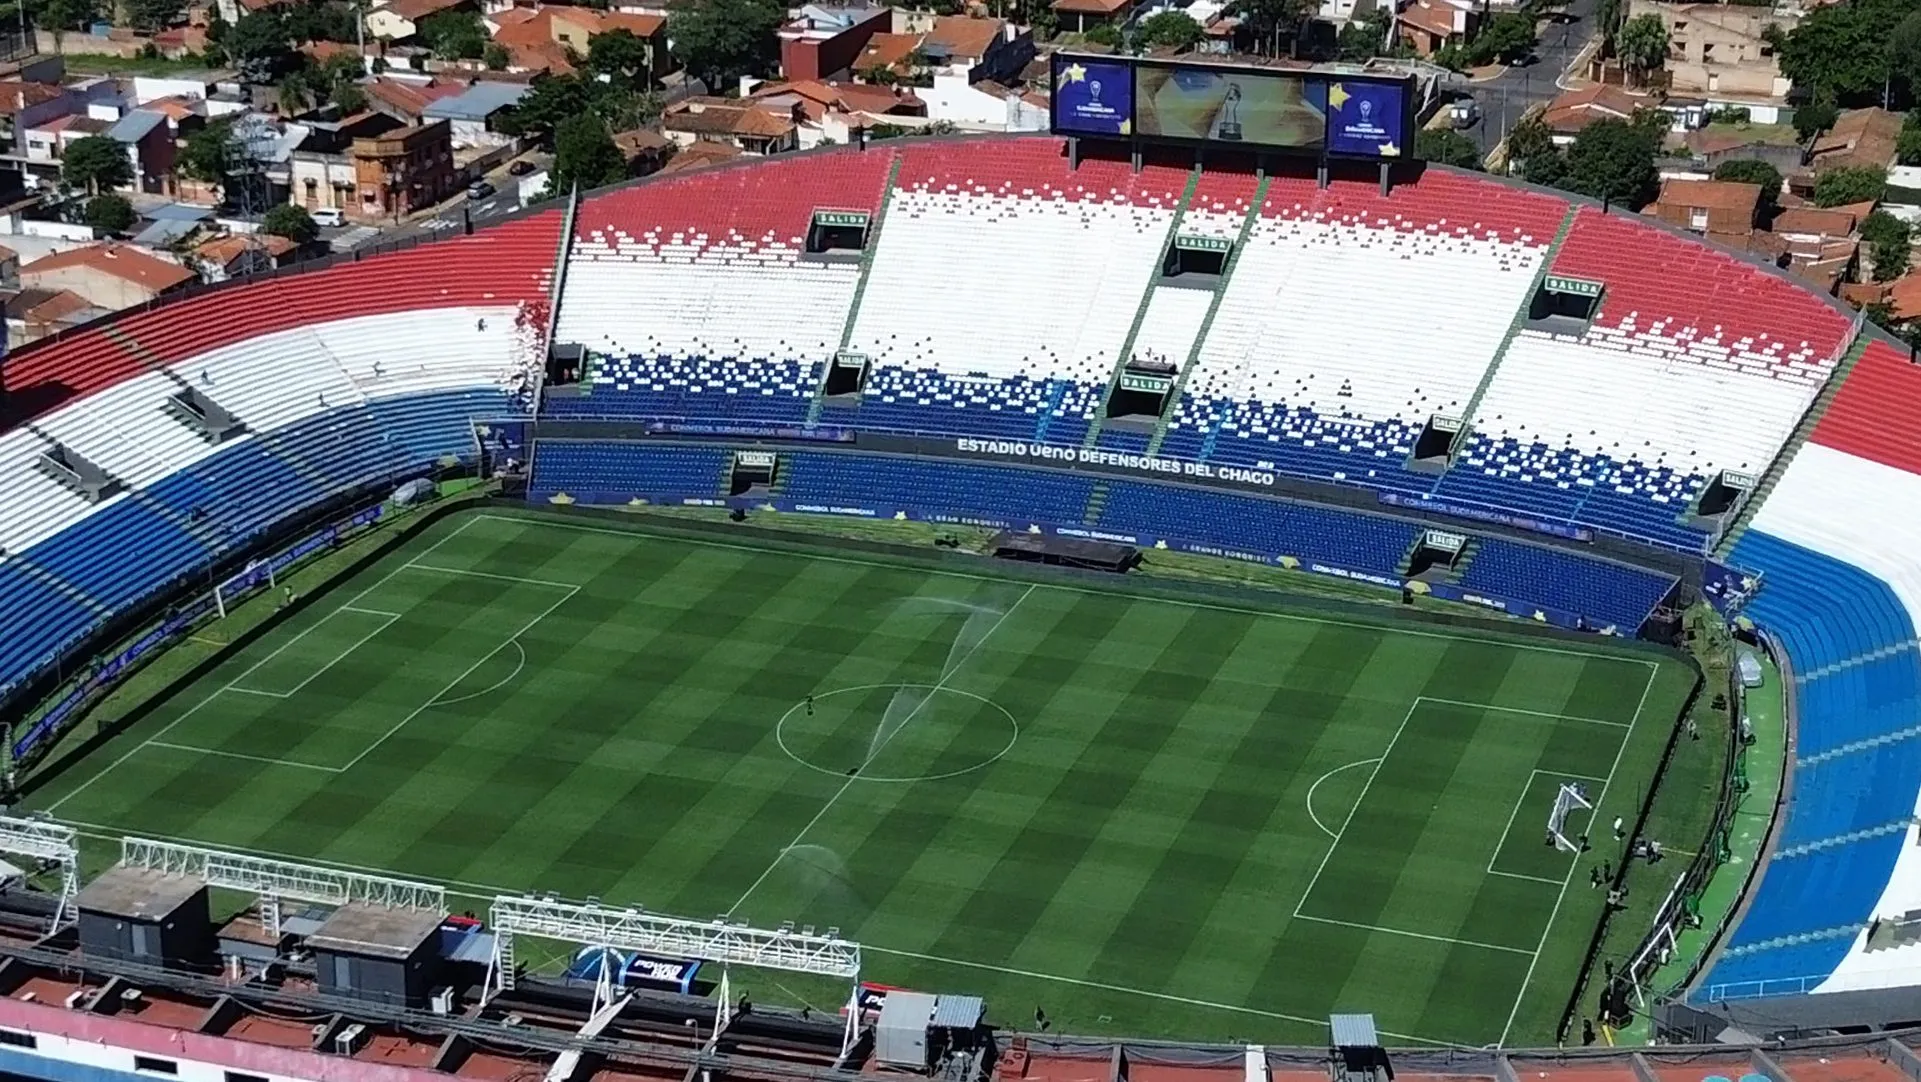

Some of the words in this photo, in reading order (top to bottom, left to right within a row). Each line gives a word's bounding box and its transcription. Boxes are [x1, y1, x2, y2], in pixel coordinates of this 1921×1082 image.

[820, 213, 864, 223] SALIDA
[1181, 238, 1226, 249] SALIDA
[1550, 279, 1597, 293] SALIDA
[1123, 378, 1169, 390] SALIDA
[957, 438, 1027, 456] ESTADIO
[1079, 450, 1181, 474] DEFENSORES
[1184, 462, 1215, 477] DEL
[1218, 467, 1274, 486] CHACO
